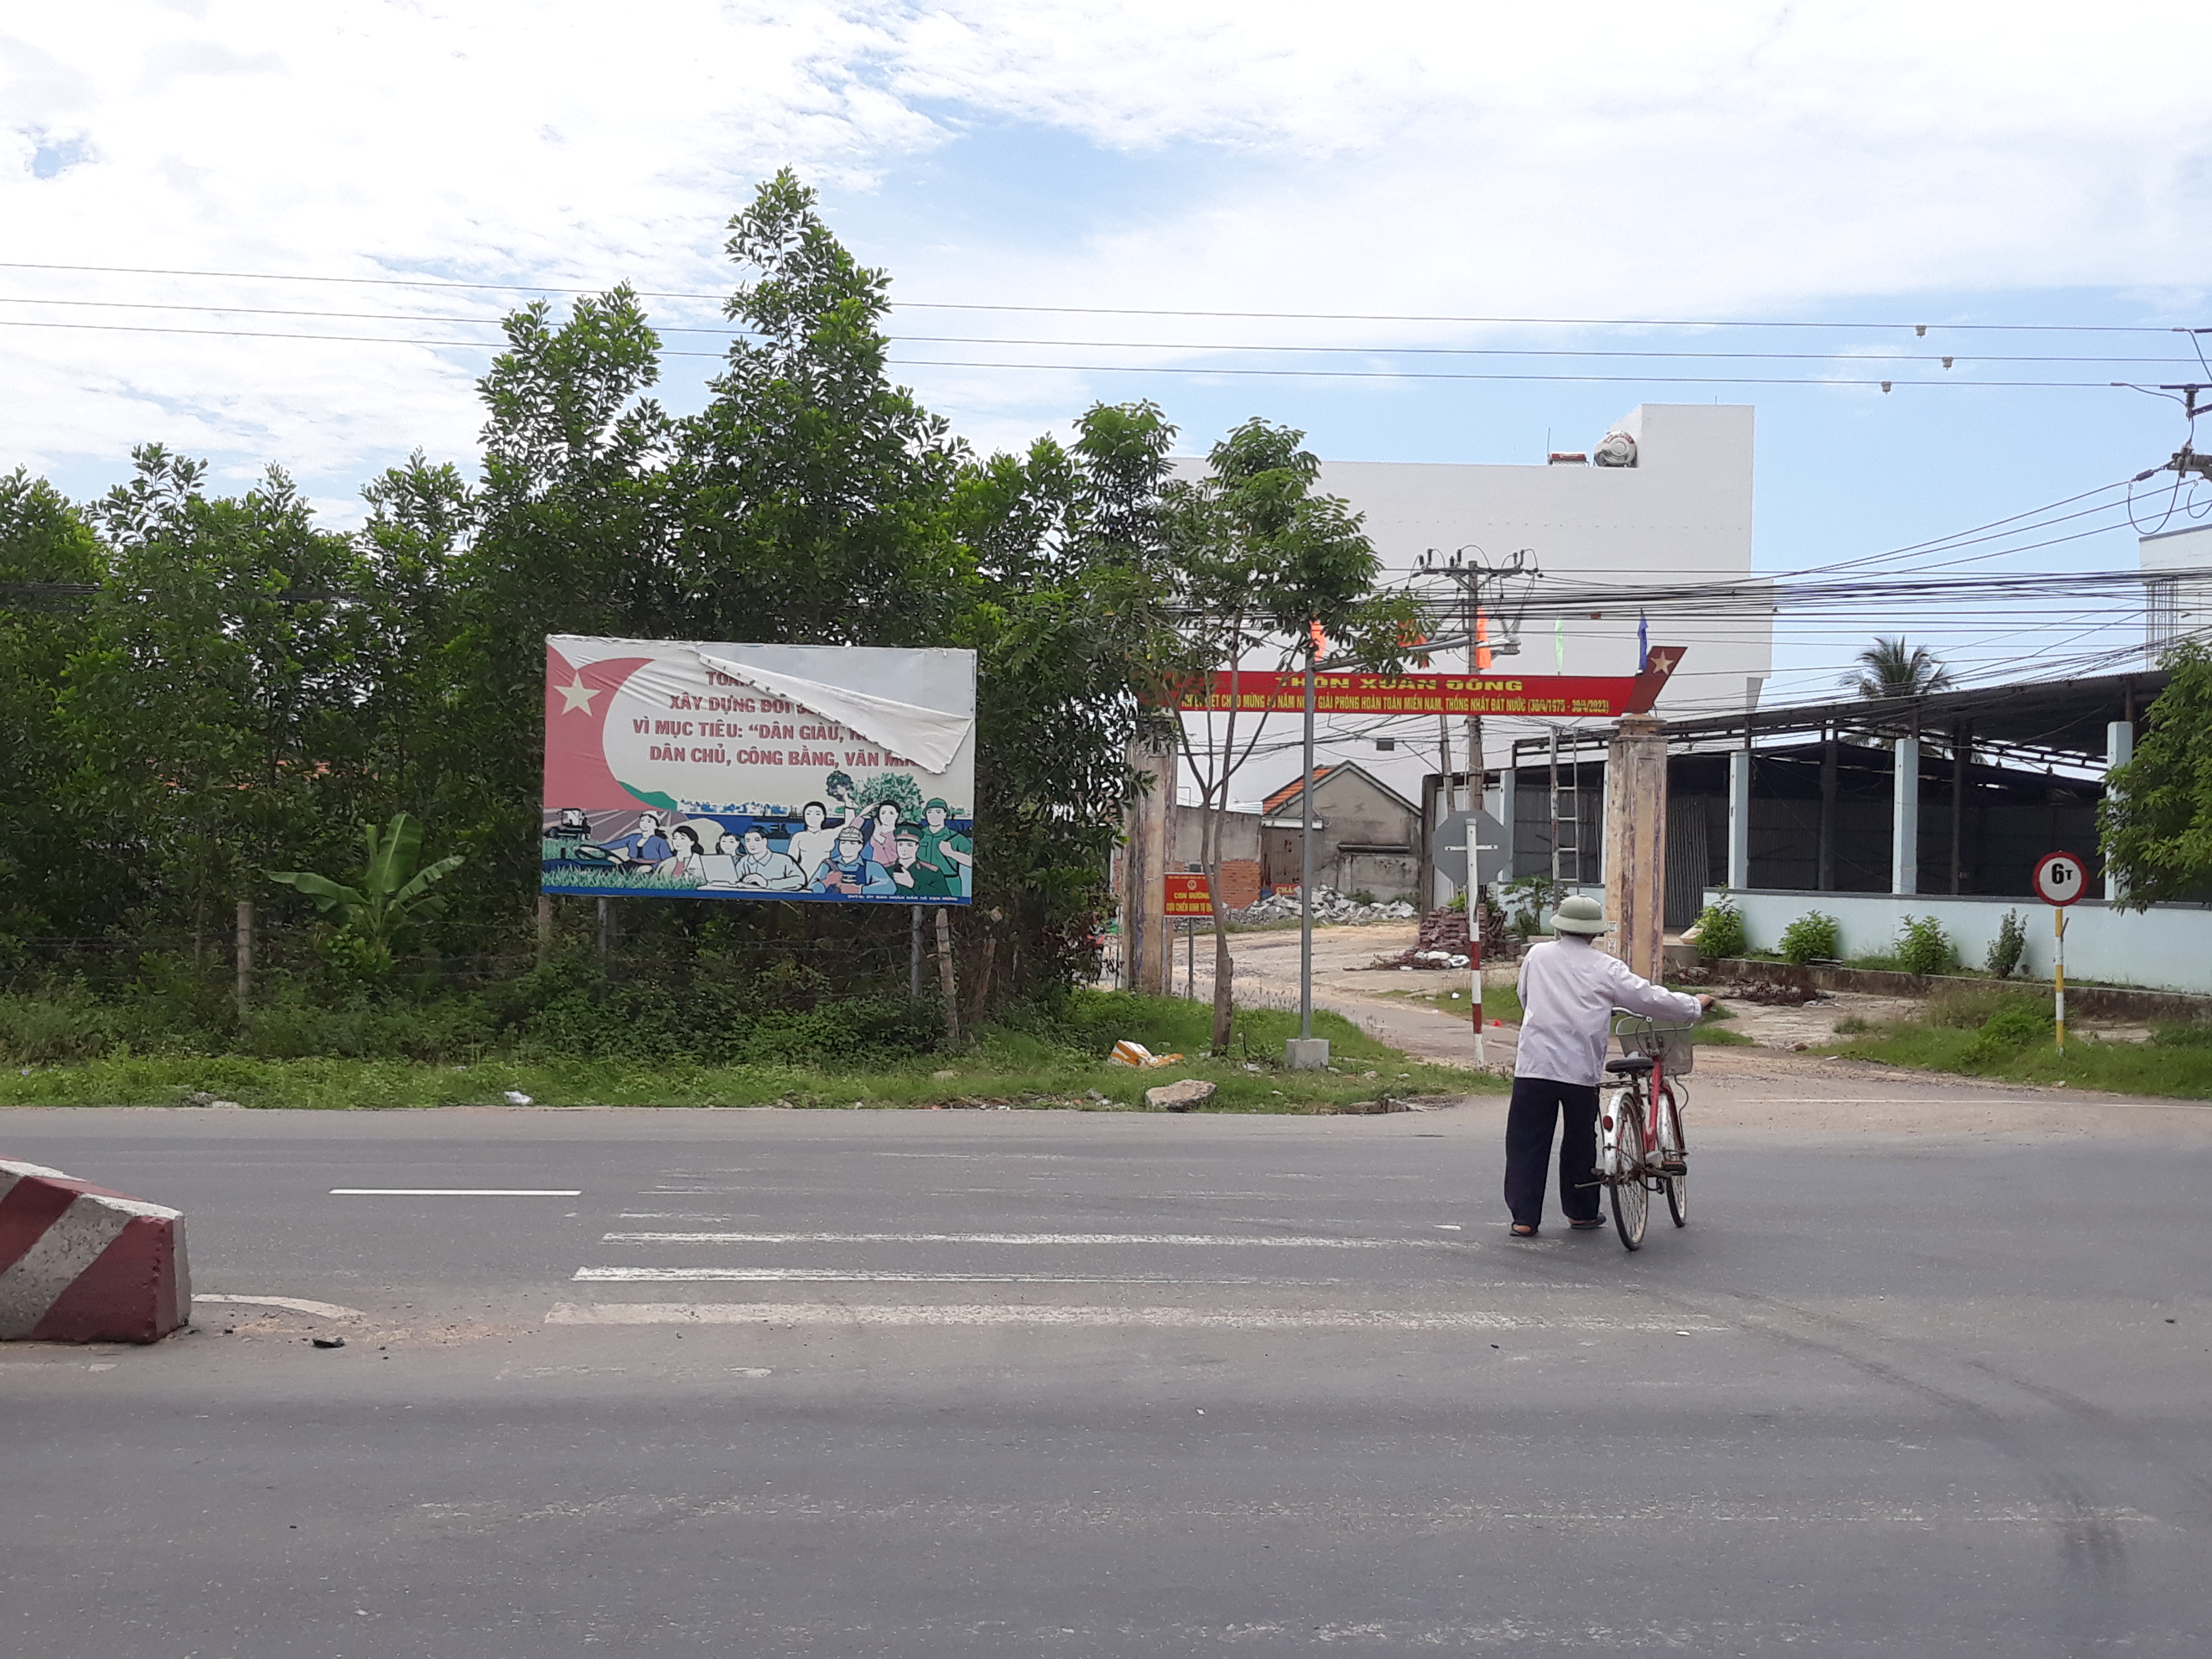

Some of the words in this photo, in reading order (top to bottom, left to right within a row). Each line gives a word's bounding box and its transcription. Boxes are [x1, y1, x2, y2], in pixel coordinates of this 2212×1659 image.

[1359, 677, 1437, 690] XUÂN
[1446, 678, 1522, 691] ĐÔNG
[670, 692, 703, 711] XÂY
[709, 695, 755, 715] DỰNG
[1222, 694, 1241, 708] CHO
[1243, 691, 1265, 708] MỪNG
[1318, 692, 1333, 709] GIẢI
[1335, 694, 1359, 709] PHÓNG
[1362, 694, 1381, 710] HOÀN
[1384, 694, 1402, 710] TOÀN
[1446, 693, 1468, 711] THỐNG
[1471, 694, 1488, 712] NHẤT
[633, 716, 649, 734] VÌ
[655, 720, 693, 739] MỤC
[698, 719, 743, 738] TIÊU:
[799, 722, 844, 743] GIÀU,
[650, 743, 685, 762] DÂN
[691, 743, 731, 766] CHỦ,
[737, 746, 783, 765] CÔNG
[788, 745, 839, 768] BẰNG,
[845, 750, 879, 766] VĂN
[2052, 863, 2073, 884] 6T
